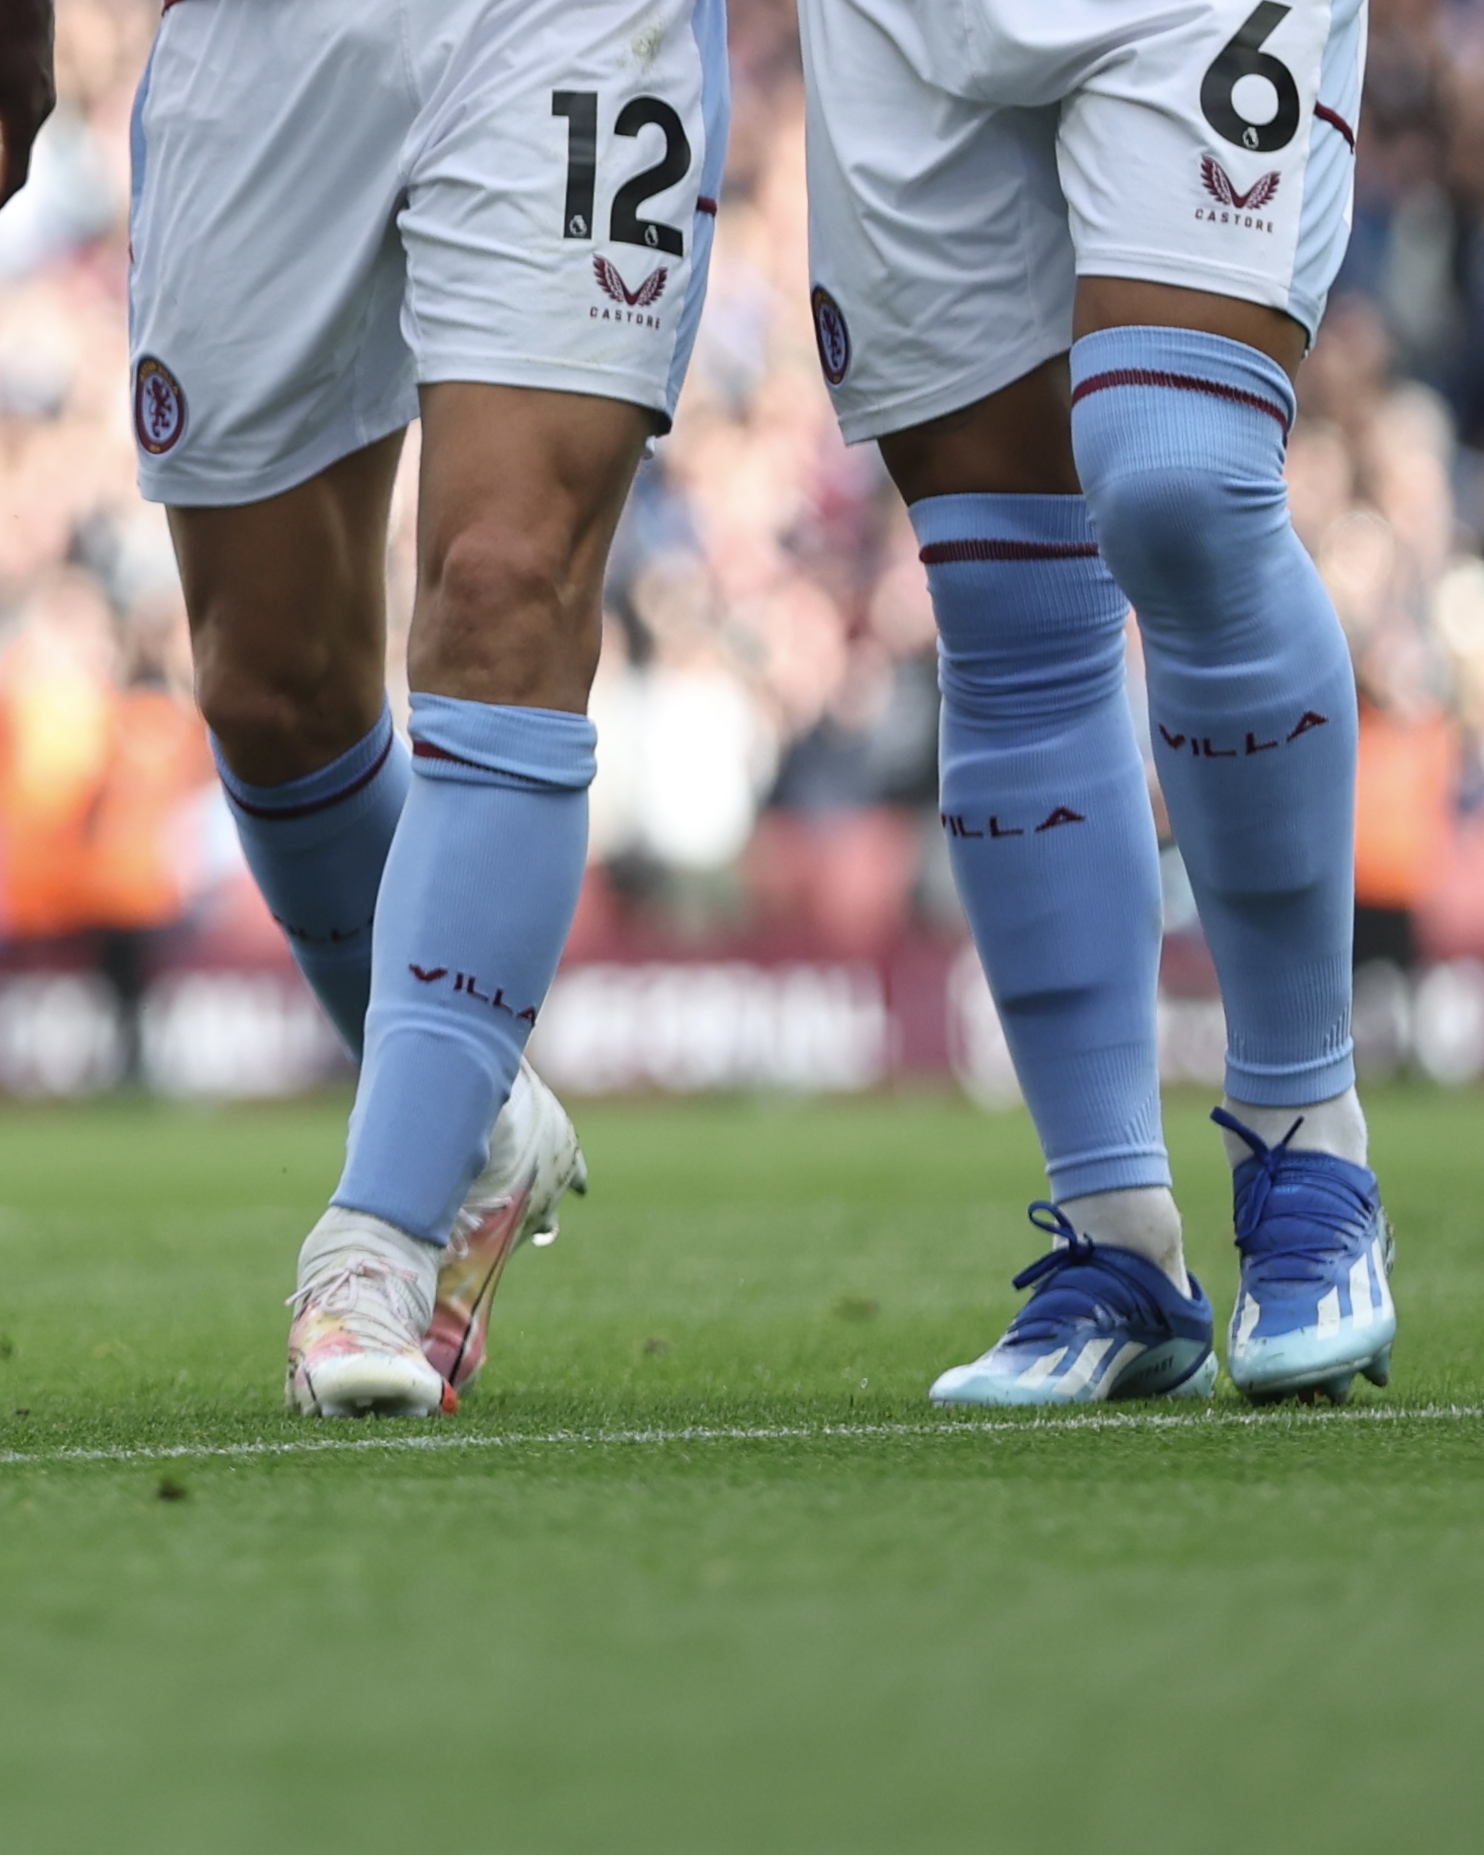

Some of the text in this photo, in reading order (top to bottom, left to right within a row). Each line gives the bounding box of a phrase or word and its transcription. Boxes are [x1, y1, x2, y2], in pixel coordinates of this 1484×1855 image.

[1200, 0, 1301, 153] 6
[552, 89, 692, 258] 12
[1195, 208, 1274, 233] CASTORE
[590, 307, 661, 330] CASTORE
[1159, 711, 1329, 758] VILLA
[408, 963, 536, 1018] VILLA
